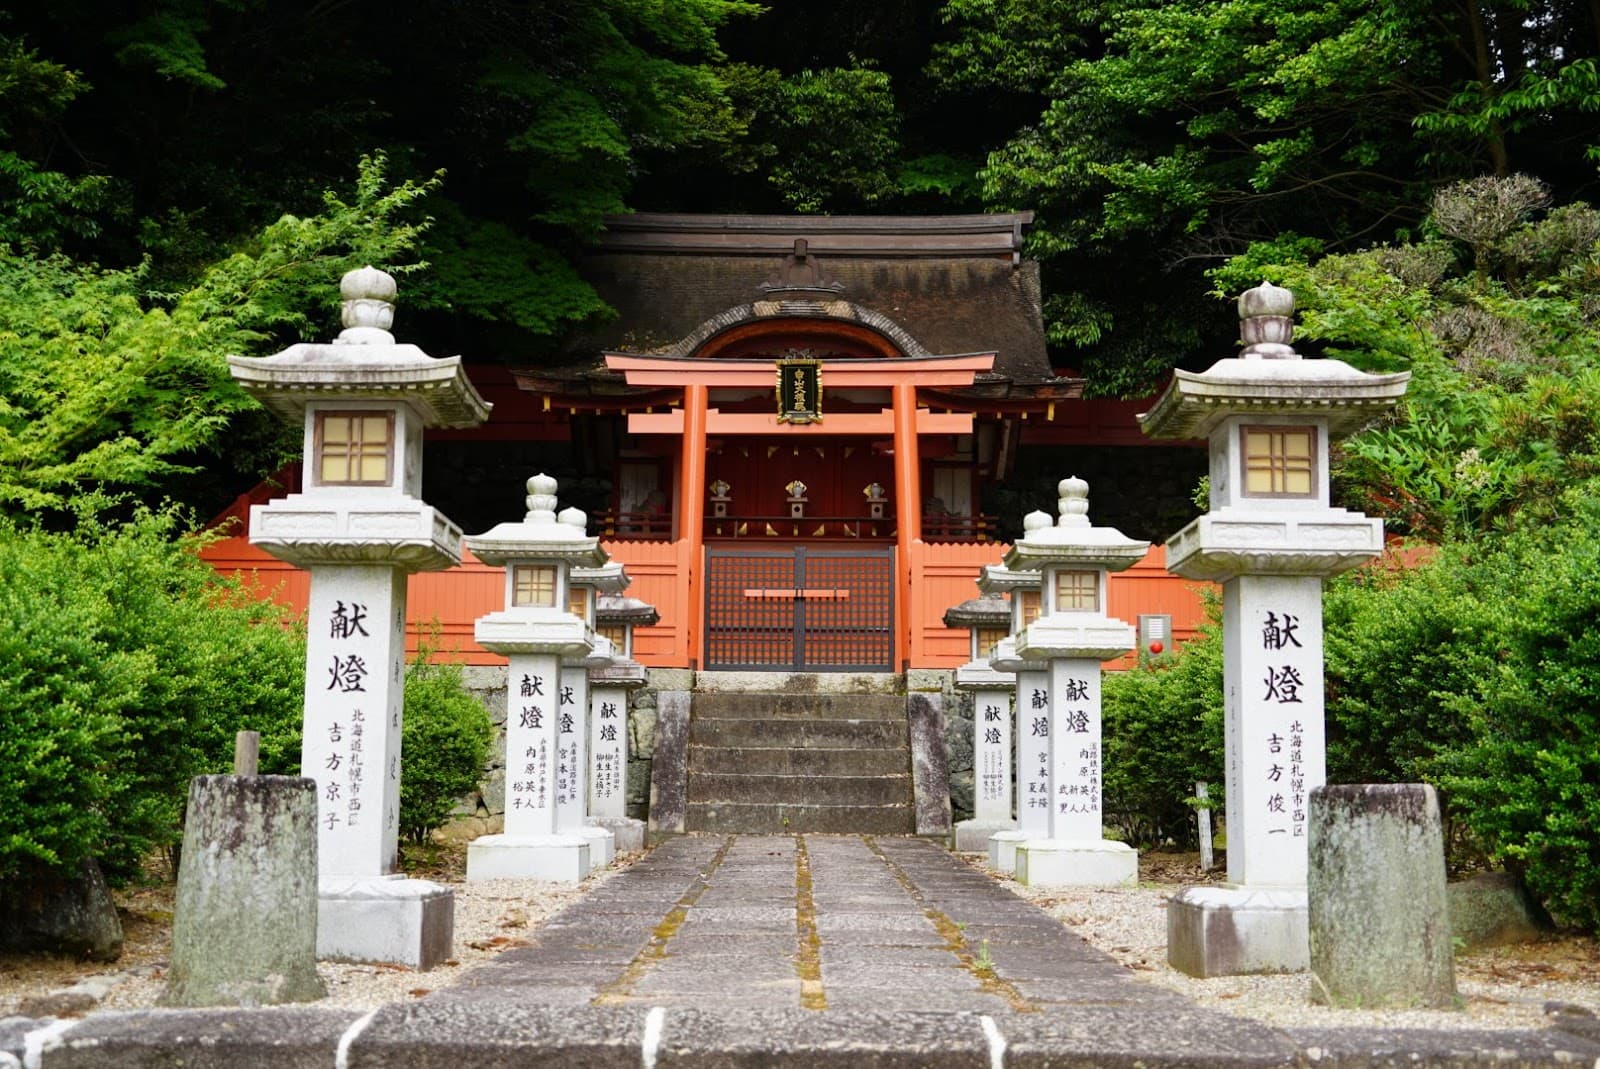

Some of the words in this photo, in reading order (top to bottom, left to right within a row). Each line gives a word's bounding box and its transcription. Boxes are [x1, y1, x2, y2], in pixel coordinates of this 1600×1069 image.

[327, 600, 370, 693] 献燈
[1262, 610, 1304, 704] 献燈
[519, 673, 545, 729] 献燈
[600, 702, 618, 742] 献燈
[984, 705, 1002, 745] 献燈
[1065, 678, 1090, 734] 献燈
[322, 722, 346, 831] 吉方京子
[347, 708, 366, 827] 北海道札幌市西区
[524, 746, 537, 809] 内原英人
[1079, 749, 1090, 814] 内原英人
[1266, 732, 1287, 834] 吉方俊一
[1289, 719, 1306, 838] 北海道札幌市西区
